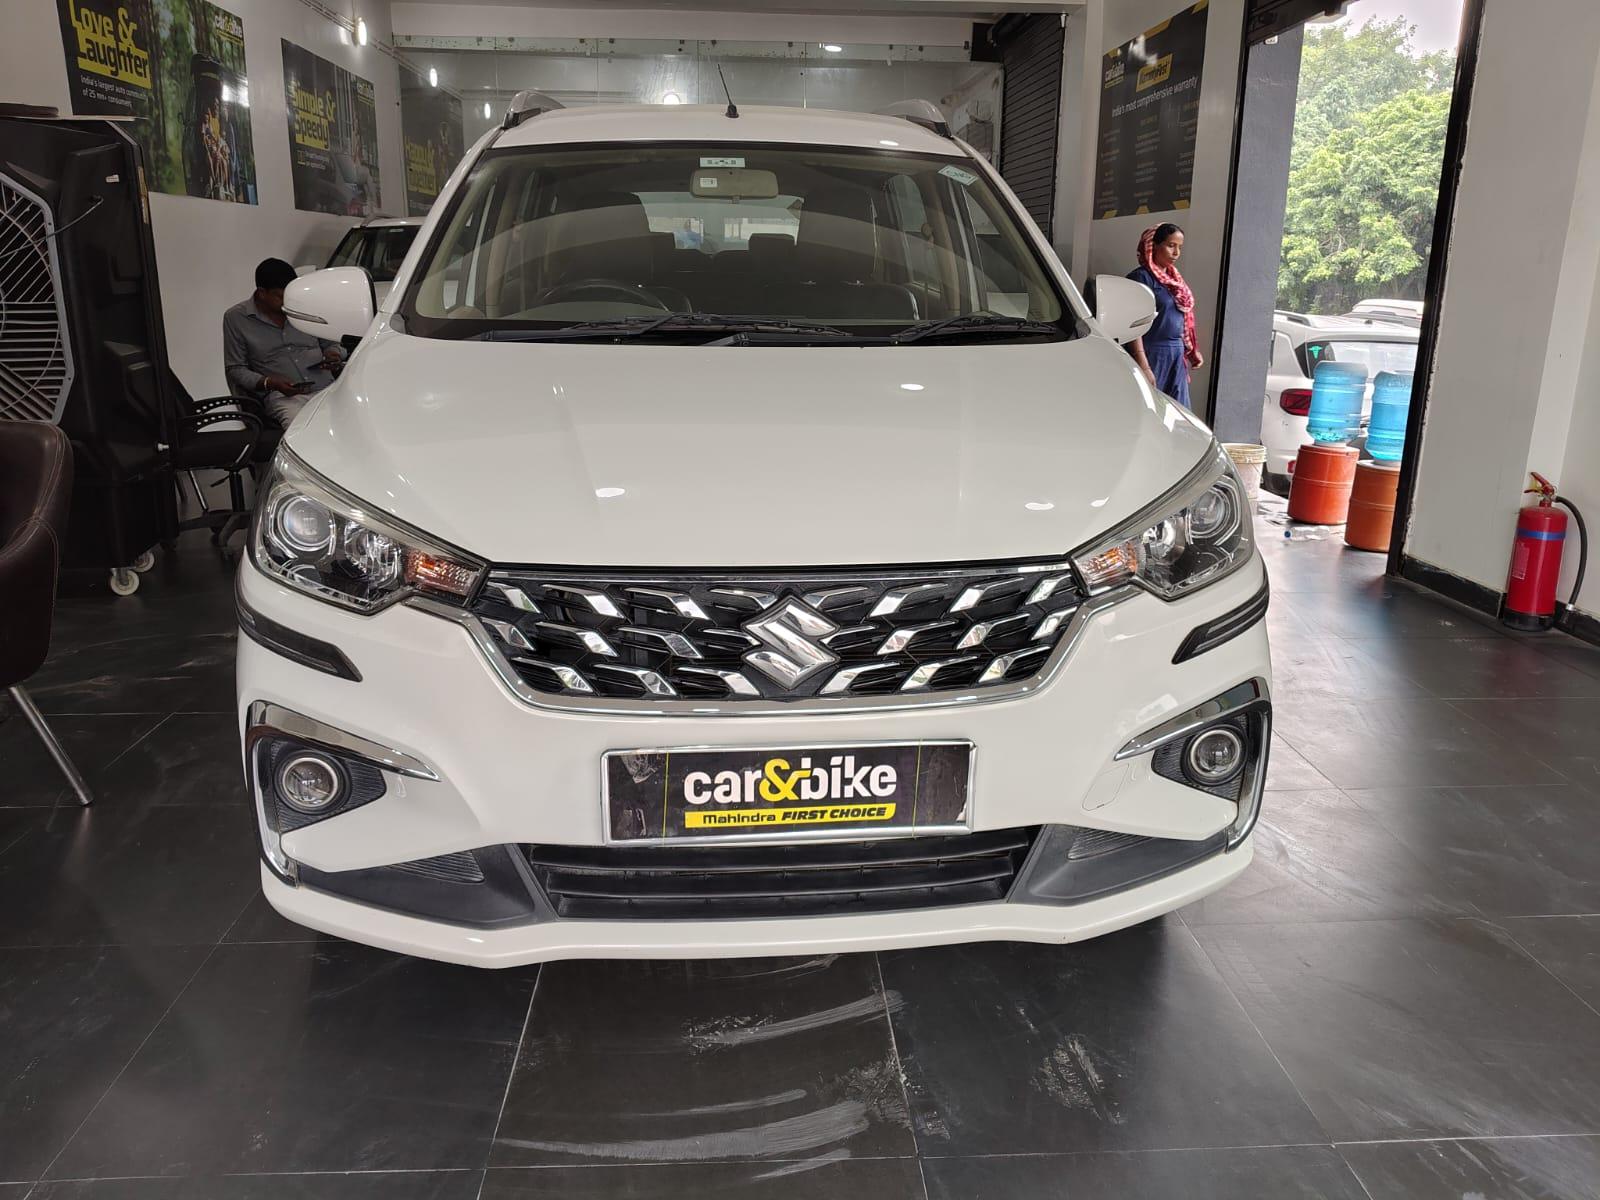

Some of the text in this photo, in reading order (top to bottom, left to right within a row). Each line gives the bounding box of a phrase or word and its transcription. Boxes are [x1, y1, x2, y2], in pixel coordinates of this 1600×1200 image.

[69, 0, 137, 49] Love &
[77, 28, 149, 79] Laughter
[88, 88, 97, 99] 25
[1125, 100, 1137, 113] most
[1137, 86, 1173, 108] comprehensive
[1173, 75, 1199, 94] warranty
[684, 755, 898, 804] car&bike
[702, 807, 887, 825] Mahindra FIRST CHOICE
